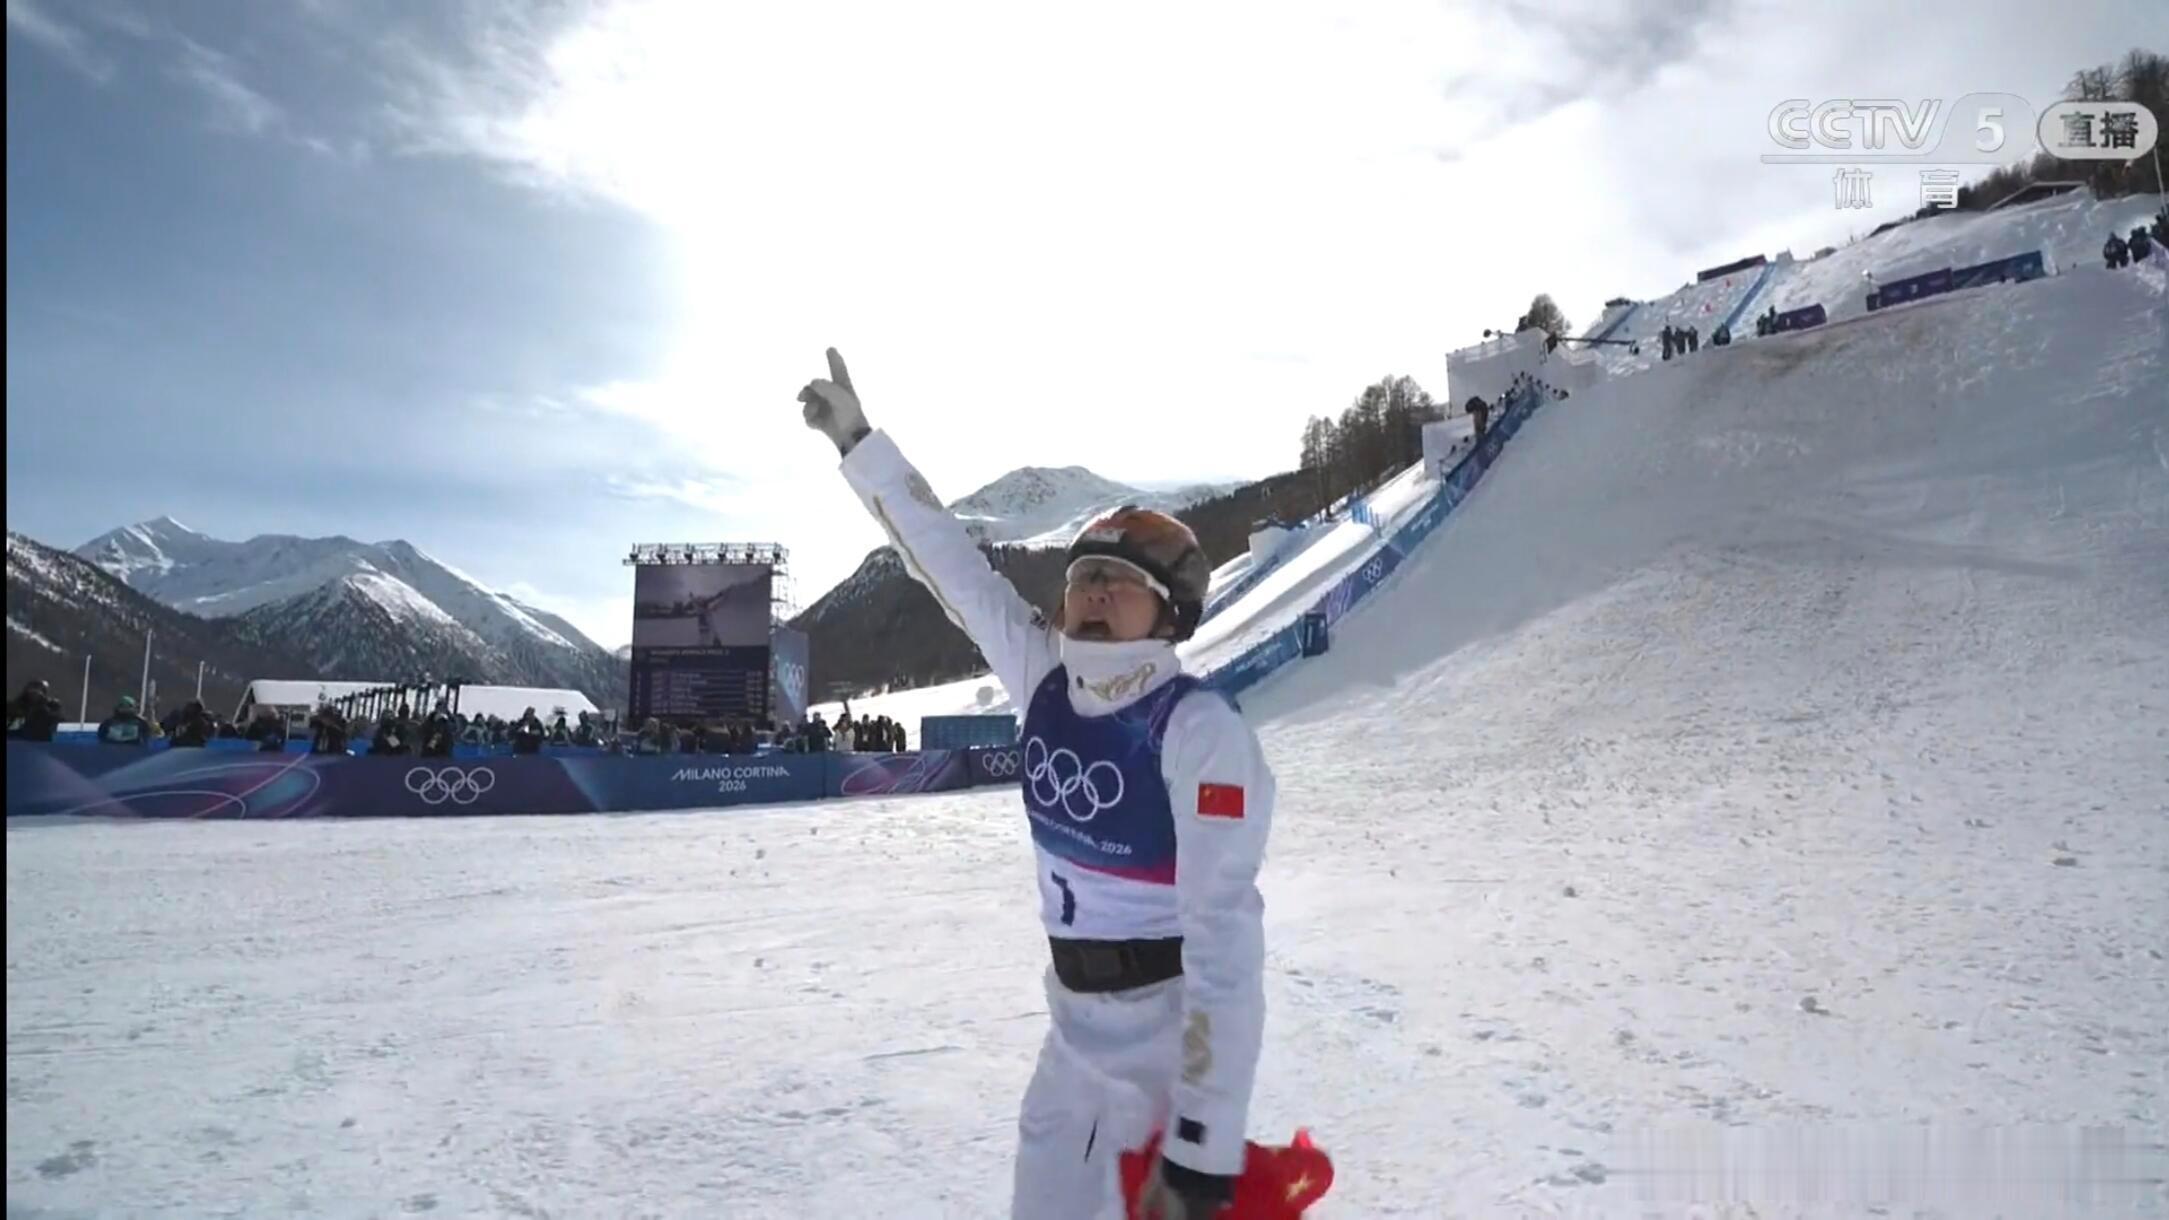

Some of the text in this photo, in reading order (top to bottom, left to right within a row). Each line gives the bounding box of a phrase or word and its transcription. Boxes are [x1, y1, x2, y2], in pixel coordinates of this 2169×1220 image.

[671, 766, 791, 781] MILANO CORTINA
[718, 780, 747, 793] 2026
[1100, 840, 1133, 856] 2026
